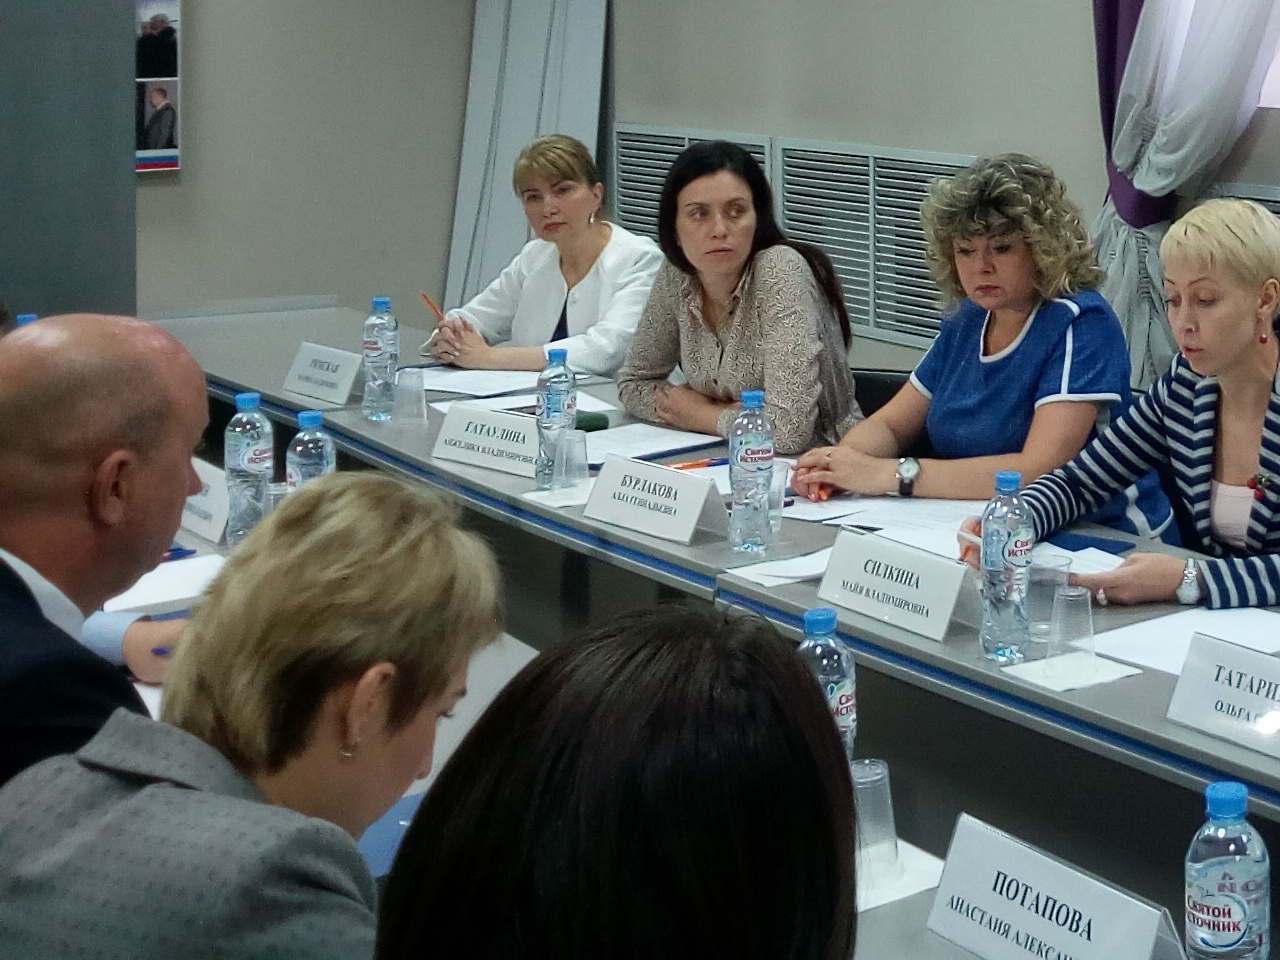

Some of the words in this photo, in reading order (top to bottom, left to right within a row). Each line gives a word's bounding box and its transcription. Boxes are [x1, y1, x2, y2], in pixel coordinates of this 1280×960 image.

[464, 420, 527, 445] ГАТАУЛИНА
[621, 474, 678, 500] БУРЛАКОВА
[863, 558, 921, 590] СИЛКИНА
[1214, 699, 1252, 723] ОЛЬГА
[992, 870, 1094, 942] ПОТАПОВА
